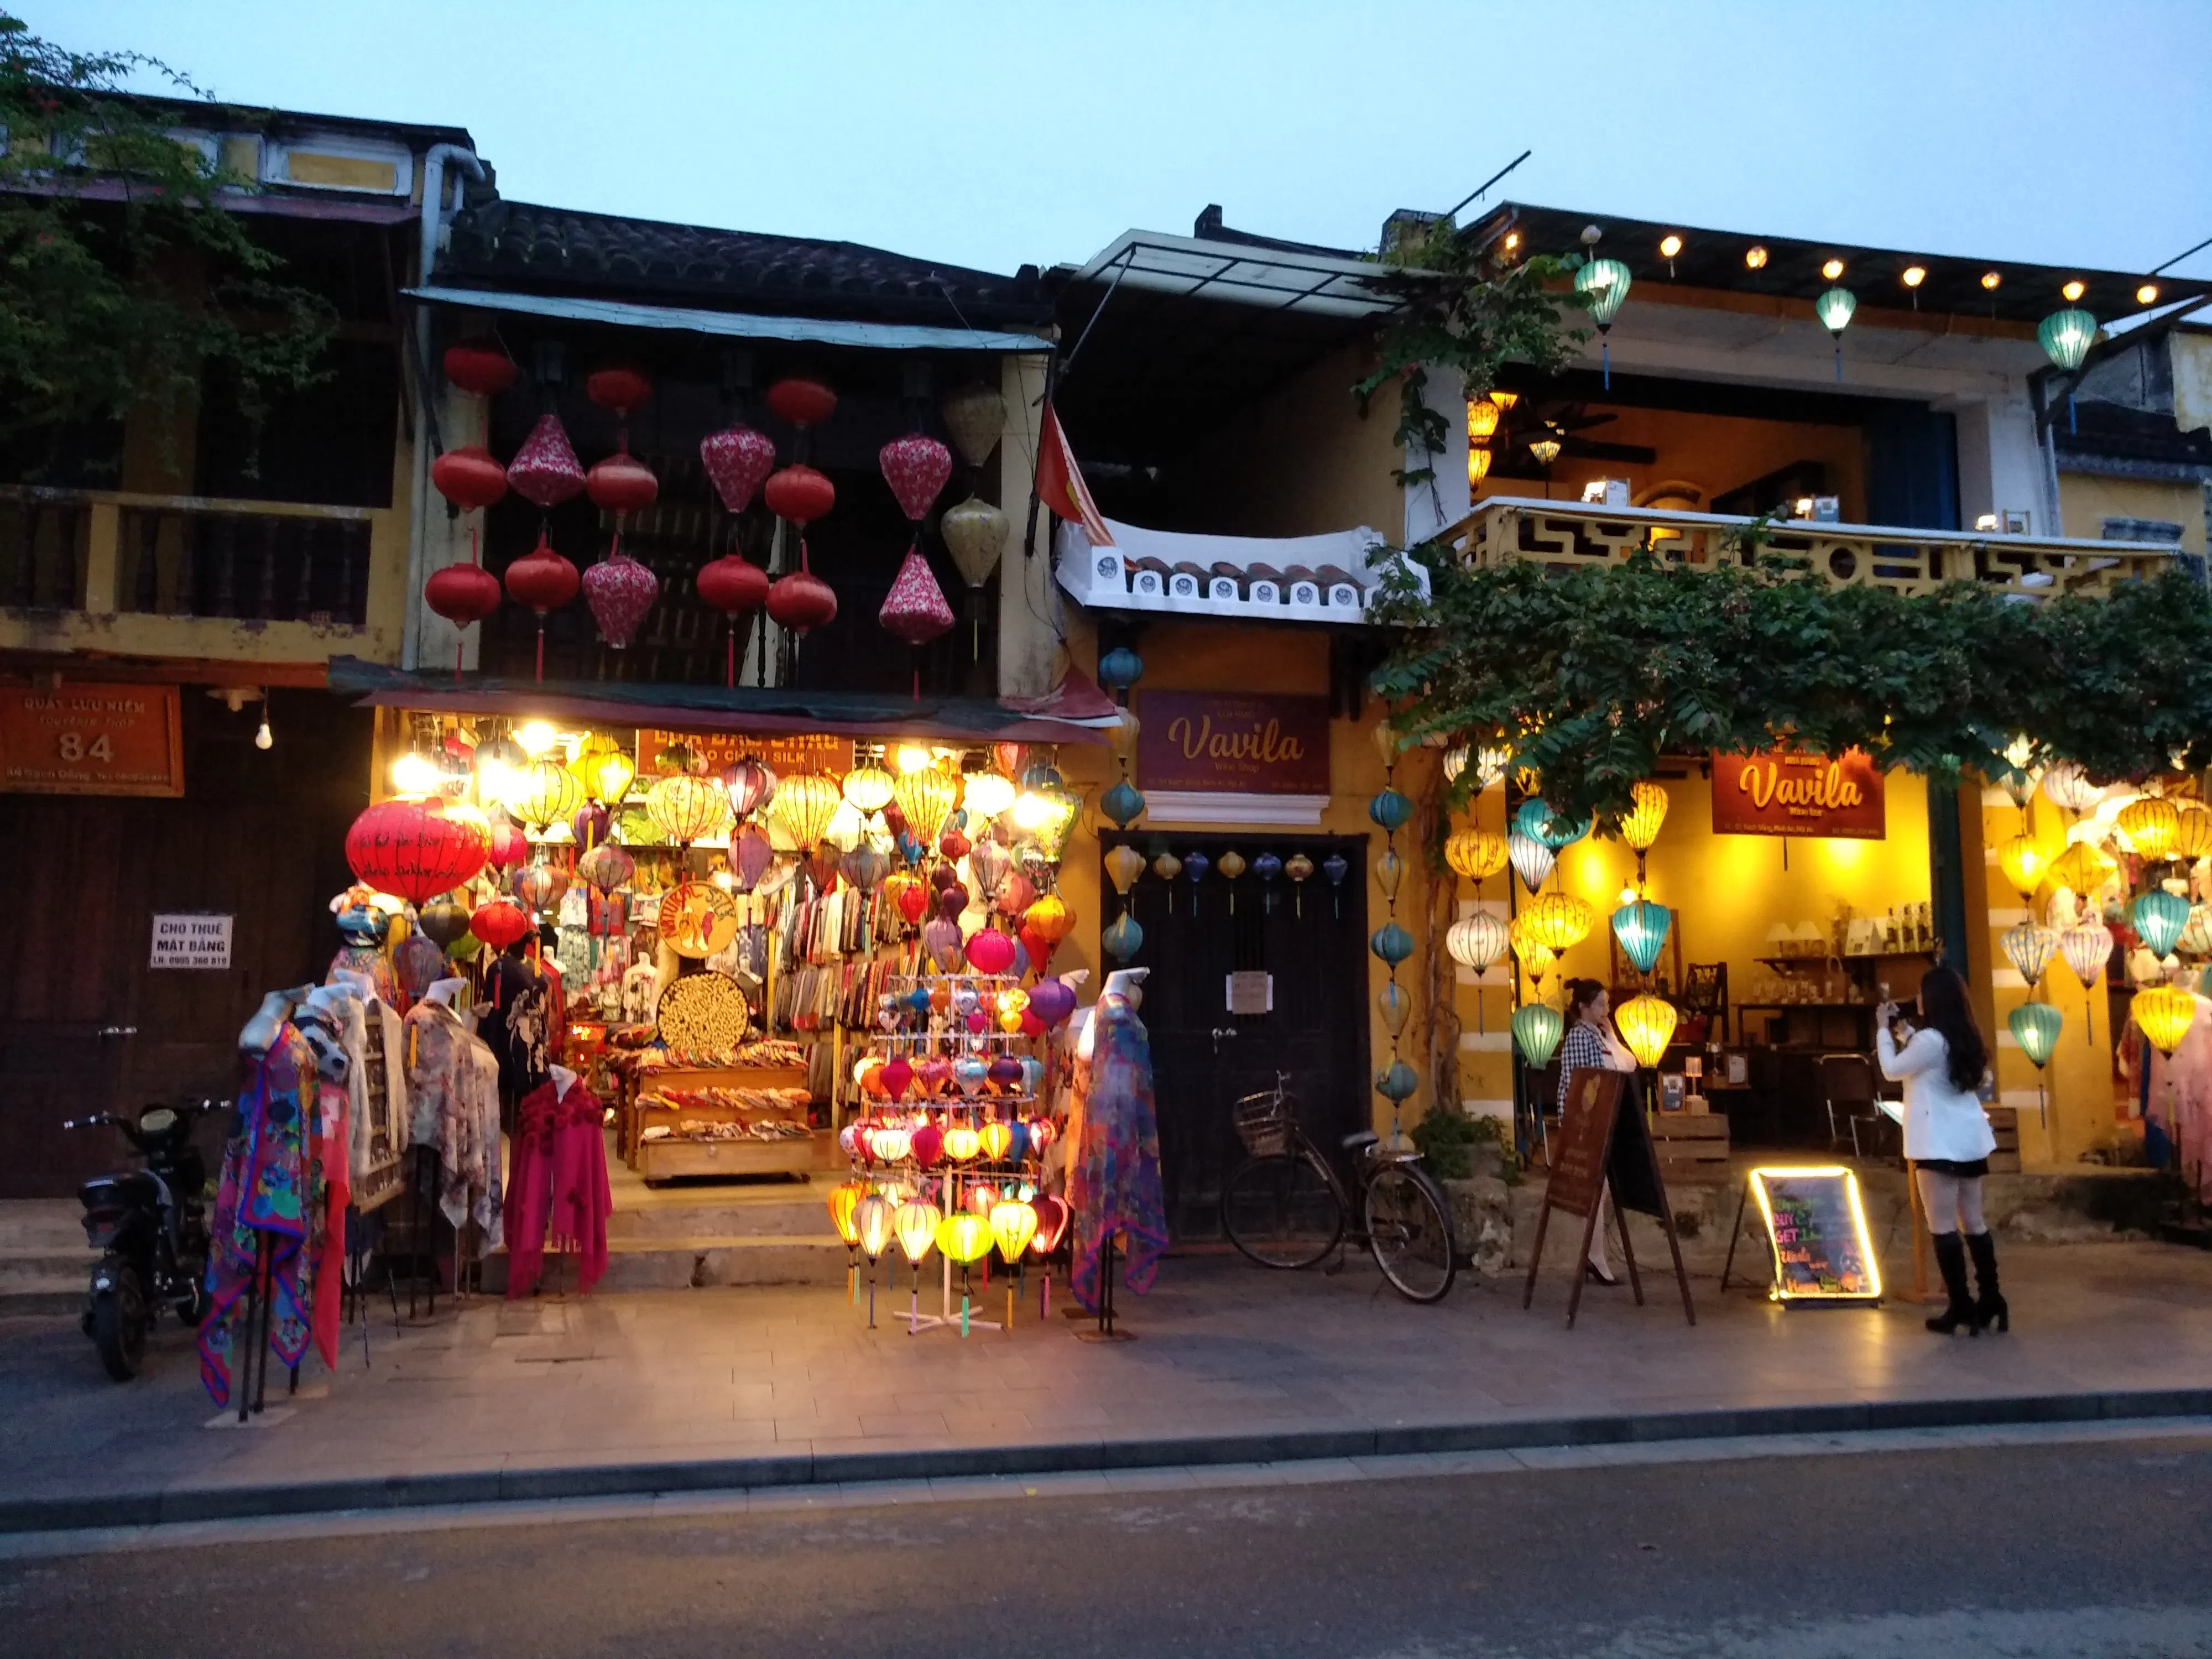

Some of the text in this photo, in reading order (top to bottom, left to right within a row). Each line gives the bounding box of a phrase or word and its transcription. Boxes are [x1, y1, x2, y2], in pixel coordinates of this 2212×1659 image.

[59, 732, 114, 763] 84
[1168, 714, 1304, 763] Vavila
[773, 751, 805, 763] SILK
[1740, 761, 1863, 808] Vavila
[160, 922, 186, 935] CHO
[1775, 1228, 1799, 1243] GET
